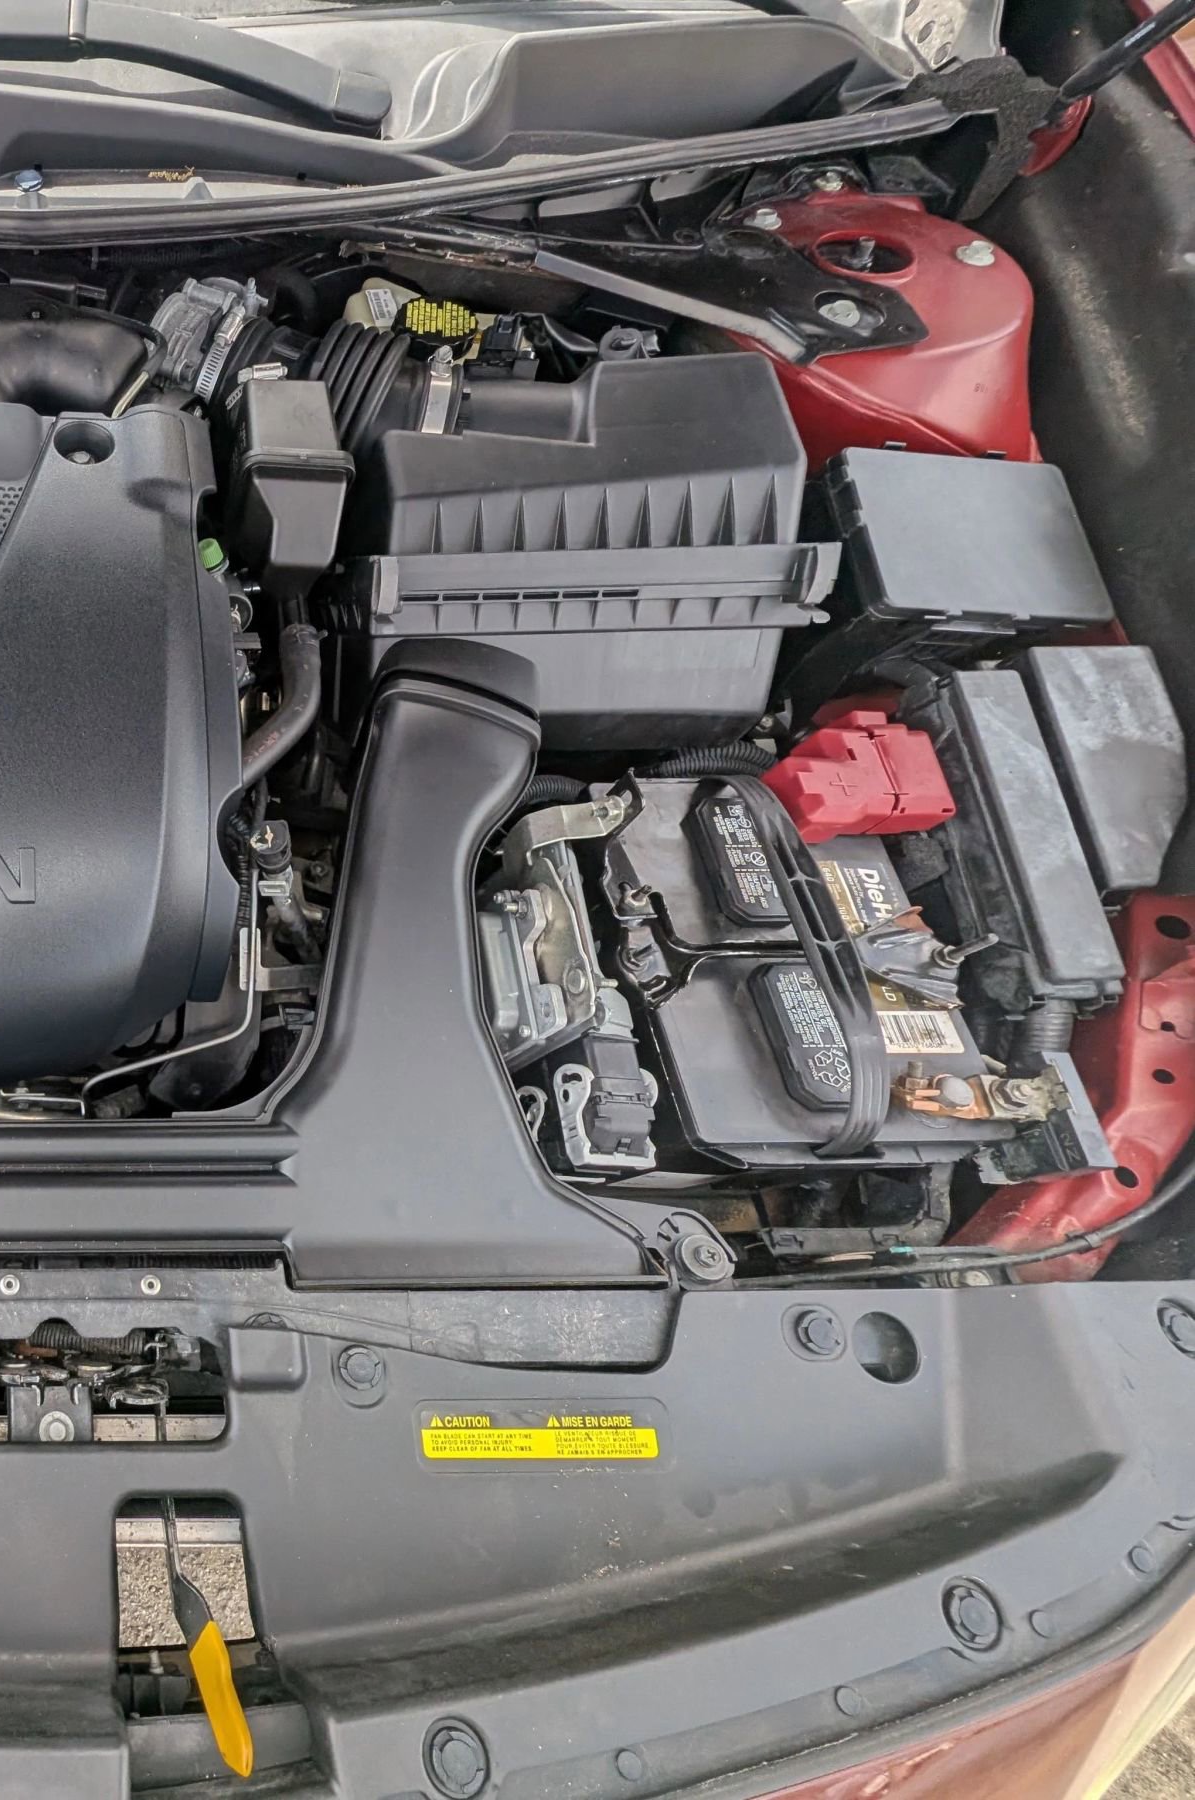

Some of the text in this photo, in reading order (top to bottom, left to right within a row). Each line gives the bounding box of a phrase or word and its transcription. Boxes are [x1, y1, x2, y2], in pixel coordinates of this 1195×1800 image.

[445, 1416, 490, 1427] CAUTION
[561, 1416, 632, 1427] MISE EN GARDE
